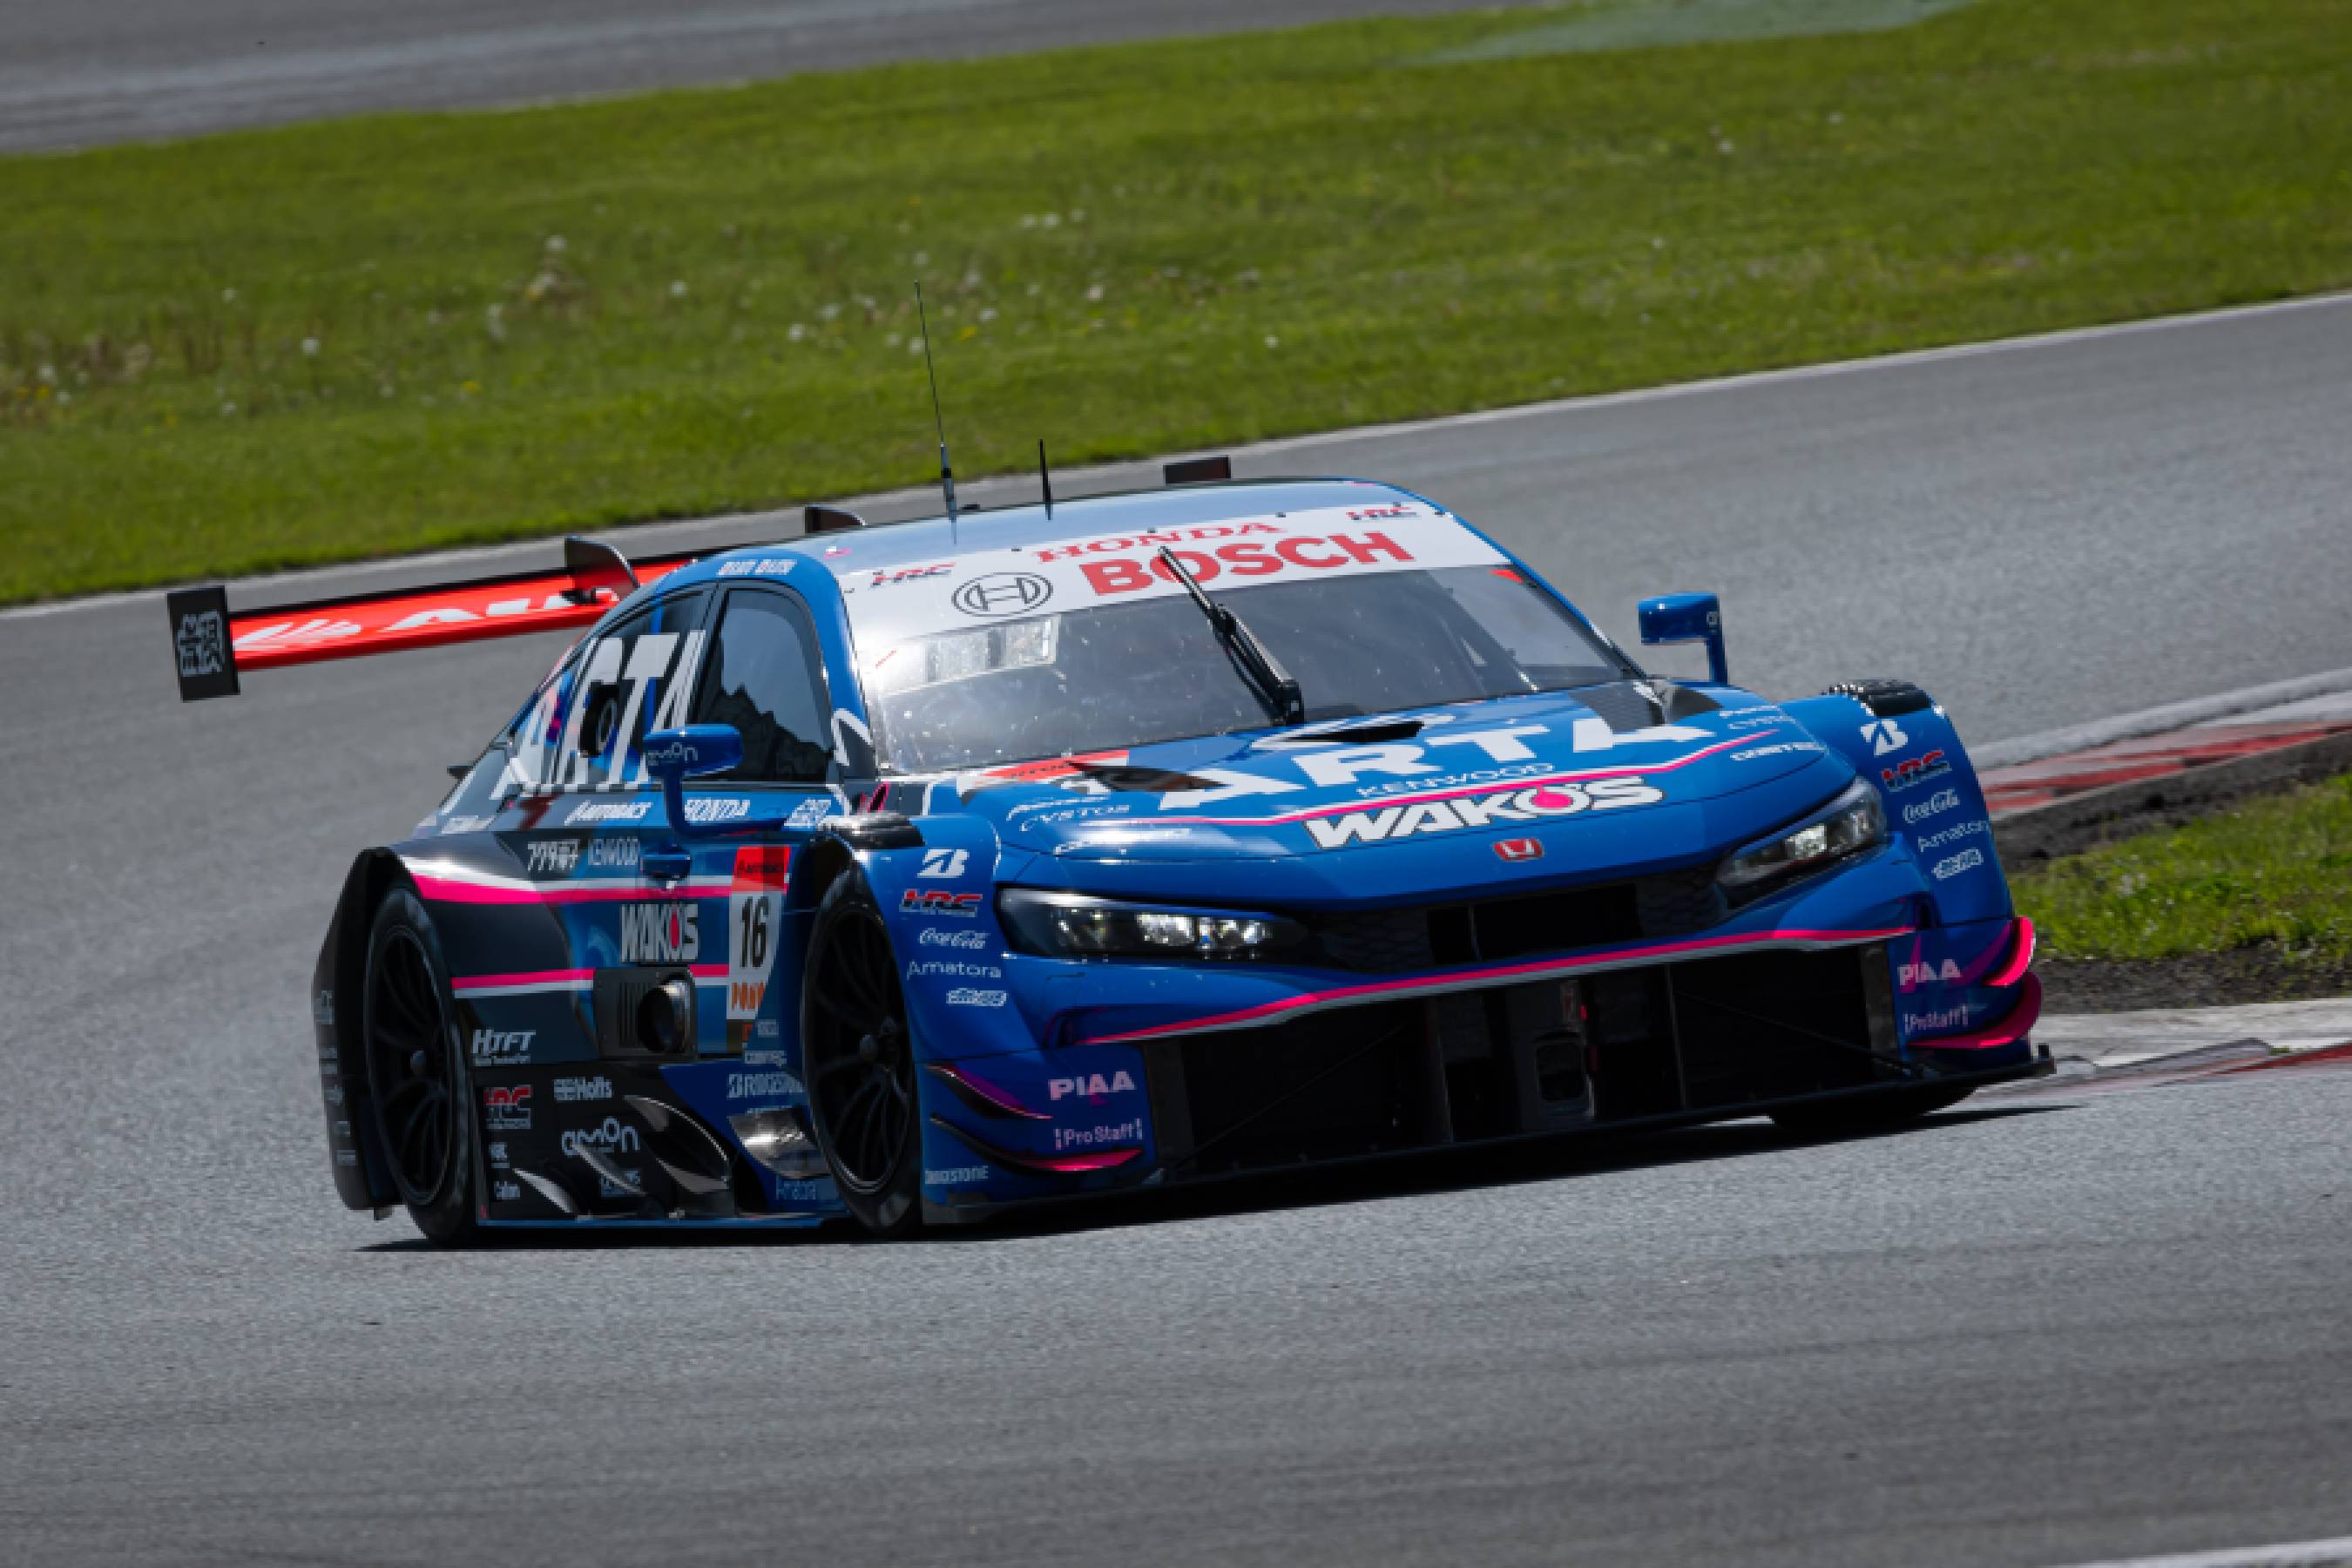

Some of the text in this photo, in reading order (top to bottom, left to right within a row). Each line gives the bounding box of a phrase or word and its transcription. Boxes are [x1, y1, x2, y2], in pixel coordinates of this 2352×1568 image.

[1033, 523, 1284, 564] HONDA
[1080, 532, 1416, 596] BOSCH
[1356, 763, 1554, 796] KENWOOD
[740, 896, 770, 970] 16
[1897, 958, 1963, 987] PIAA
[1048, 1071, 1137, 1101] PIAA
